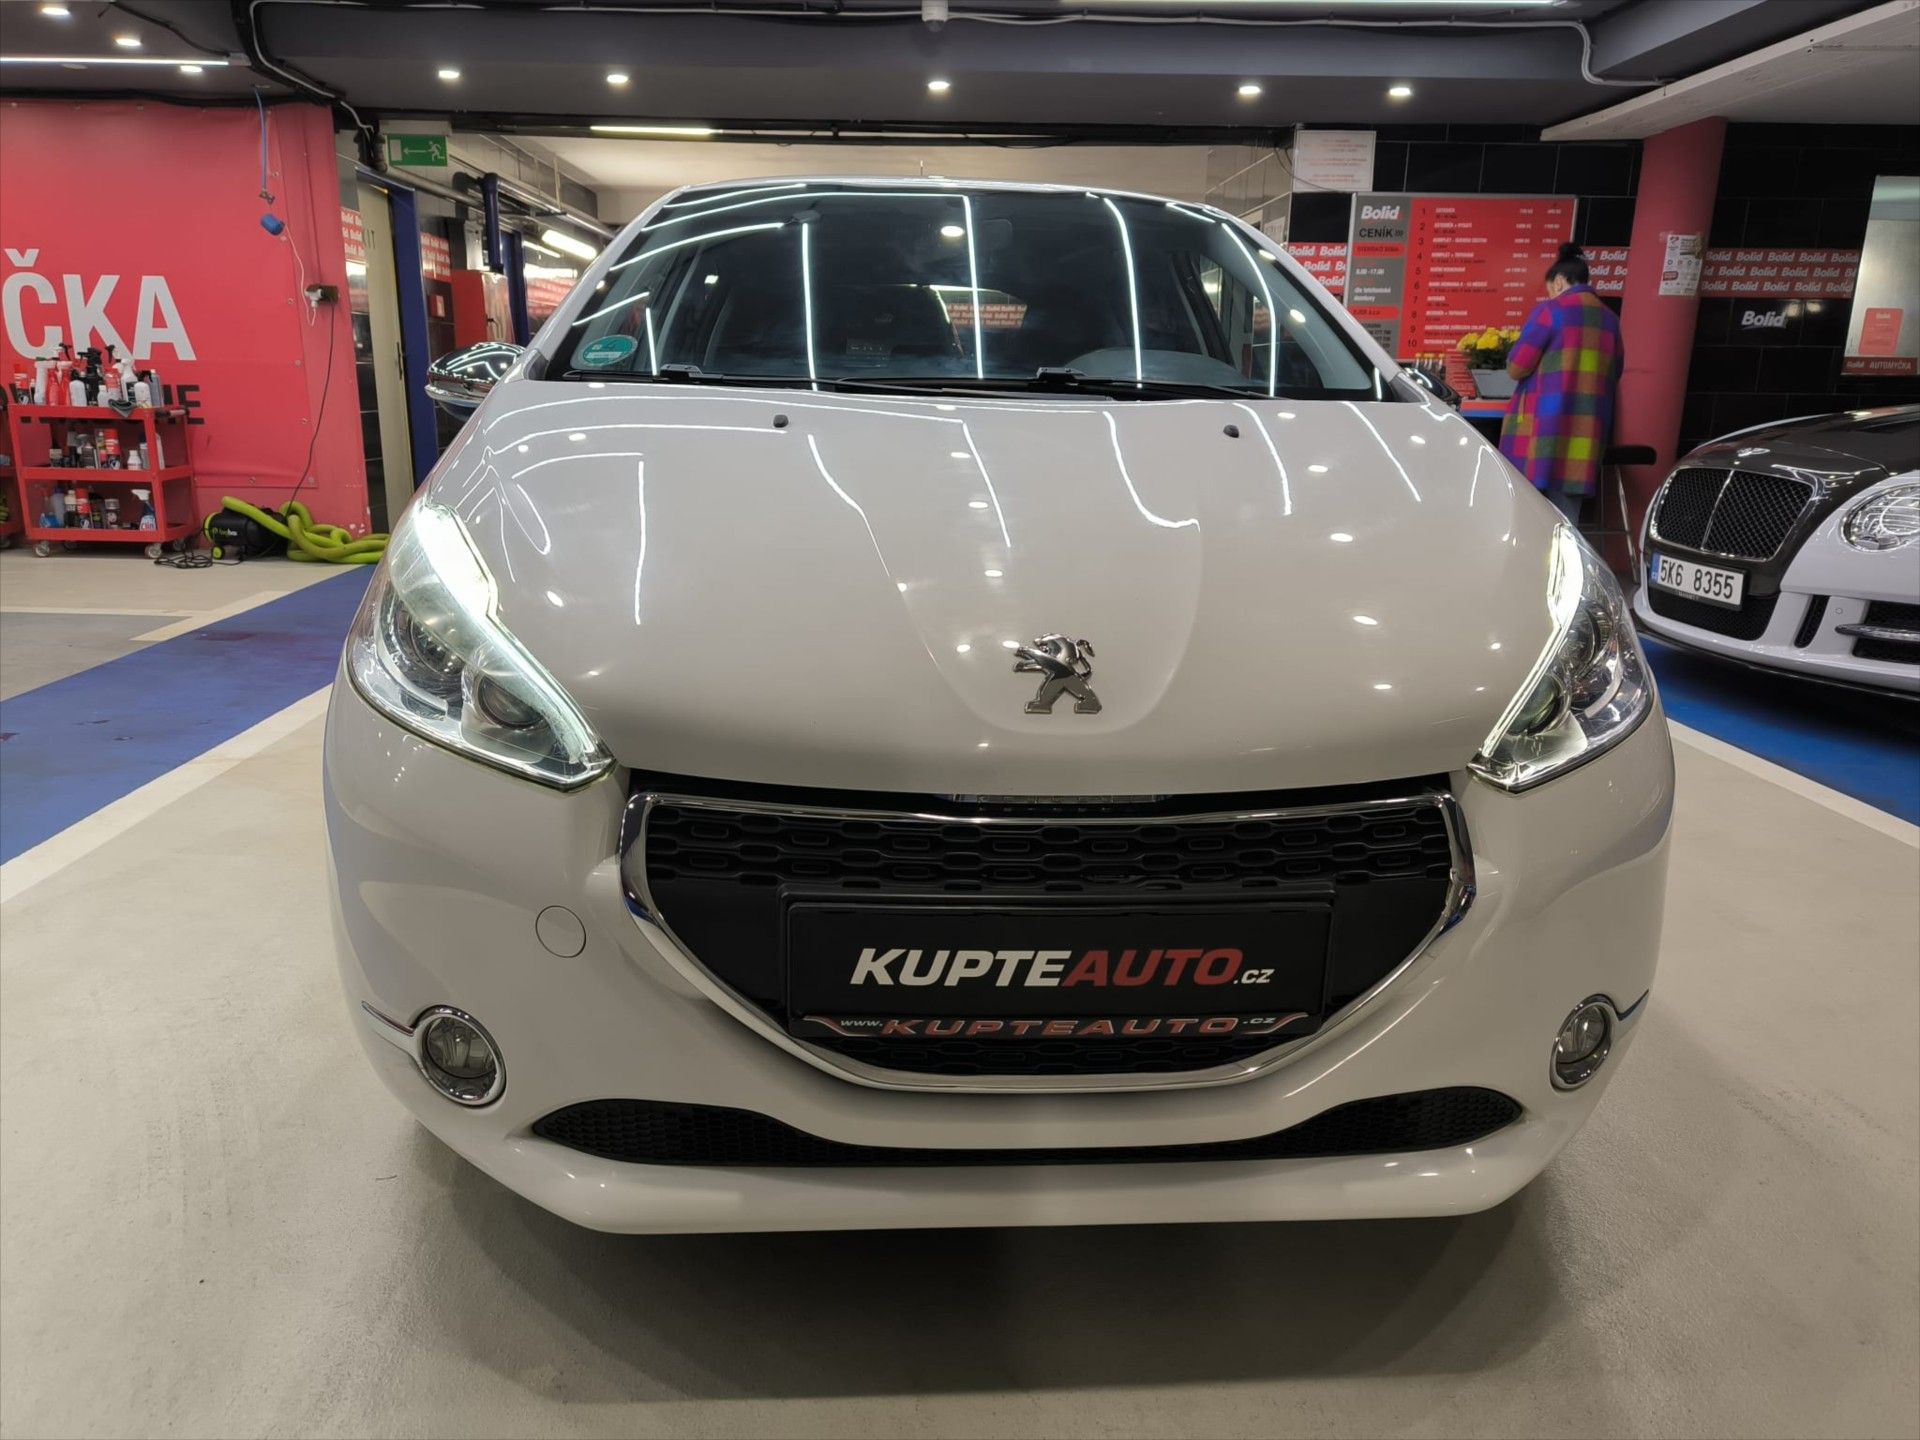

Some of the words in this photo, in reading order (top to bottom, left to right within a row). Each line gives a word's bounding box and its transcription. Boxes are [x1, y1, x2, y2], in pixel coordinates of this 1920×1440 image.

[1360, 205, 1400, 220] Bolid
[1359, 227, 1394, 238] CENÍK
[1289, 245, 1316, 256] Bolid
[1320, 245, 1347, 256] Bolid
[1600, 250, 1627, 261] Bolid
[1736, 251, 1763, 262] Bolid
[1767, 252, 1795, 263] Bolid
[1799, 252, 1826, 263] Bolid
[1831, 253, 1858, 263] Bolid
[1588, 265, 1610, 275] olid
[1719, 265, 1746, 276] Bolid
[1750, 266, 1777, 277] Bolid
[1781, 266, 1809, 277] Bolid
[1813, 267, 1840, 277] Bolid
[1596, 280, 1623, 290] Bolid
[1731, 281, 1759, 291] Bolid
[1762, 281, 1790, 292] Bolid
[1794, 282, 1821, 292] Bolid
[1826, 282, 1853, 293] Bolid
[1741, 310, 1786, 328] Bolid
[1408, 339, 1417, 348] 10
[1660, 559, 1684, 586] 5K6
[1693, 568, 1735, 599] 8355
